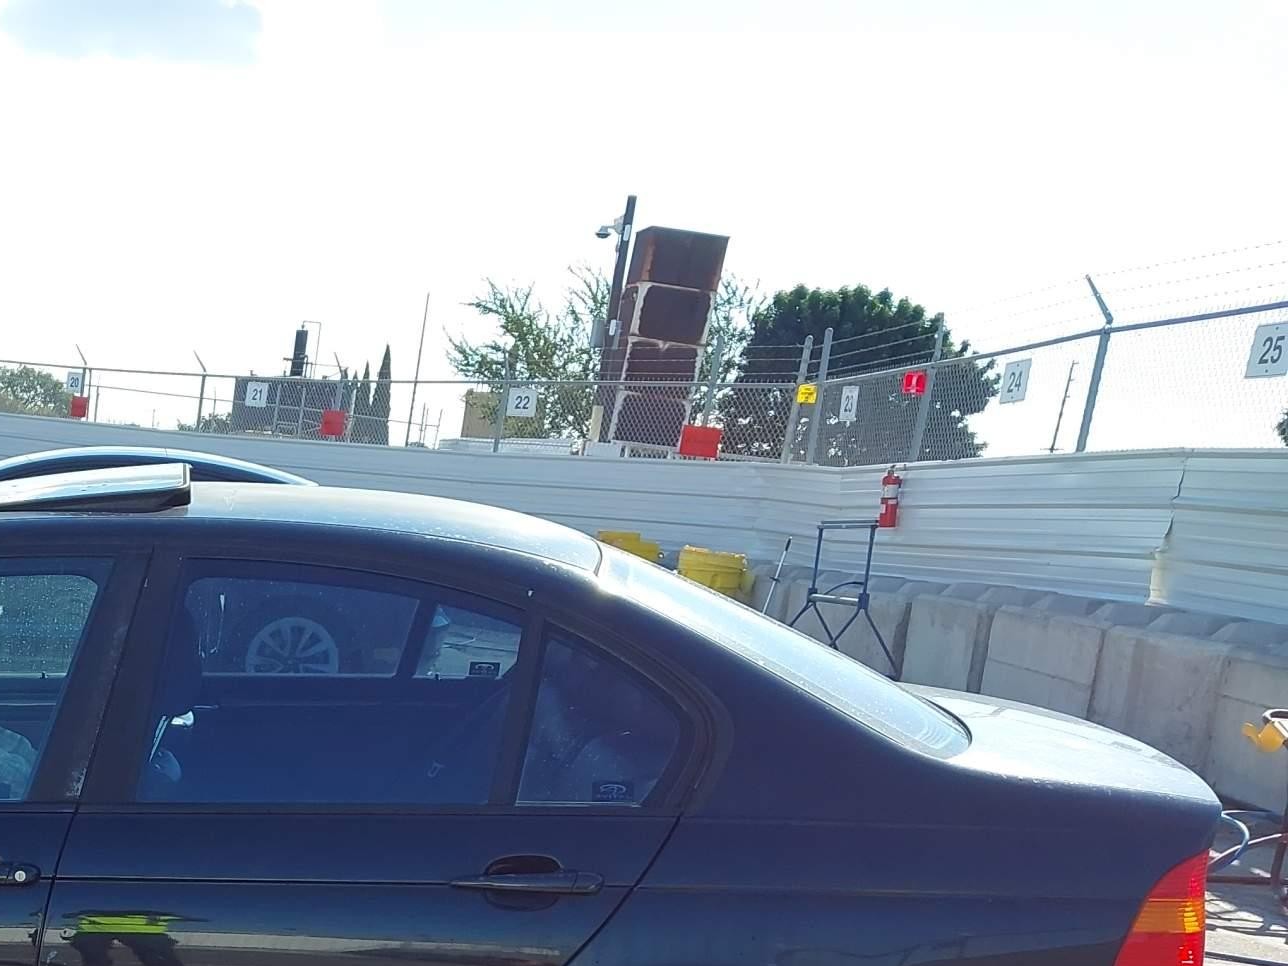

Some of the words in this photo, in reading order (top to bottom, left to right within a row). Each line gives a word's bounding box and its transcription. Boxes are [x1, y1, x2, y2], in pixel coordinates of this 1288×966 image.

[1258, 335, 1285, 364] 25
[69, 376, 80, 388] 20
[1007, 370, 1023, 393] 24
[252, 388, 263, 401] 21
[514, 395, 530, 410] 22
[843, 395, 854, 413] 23
